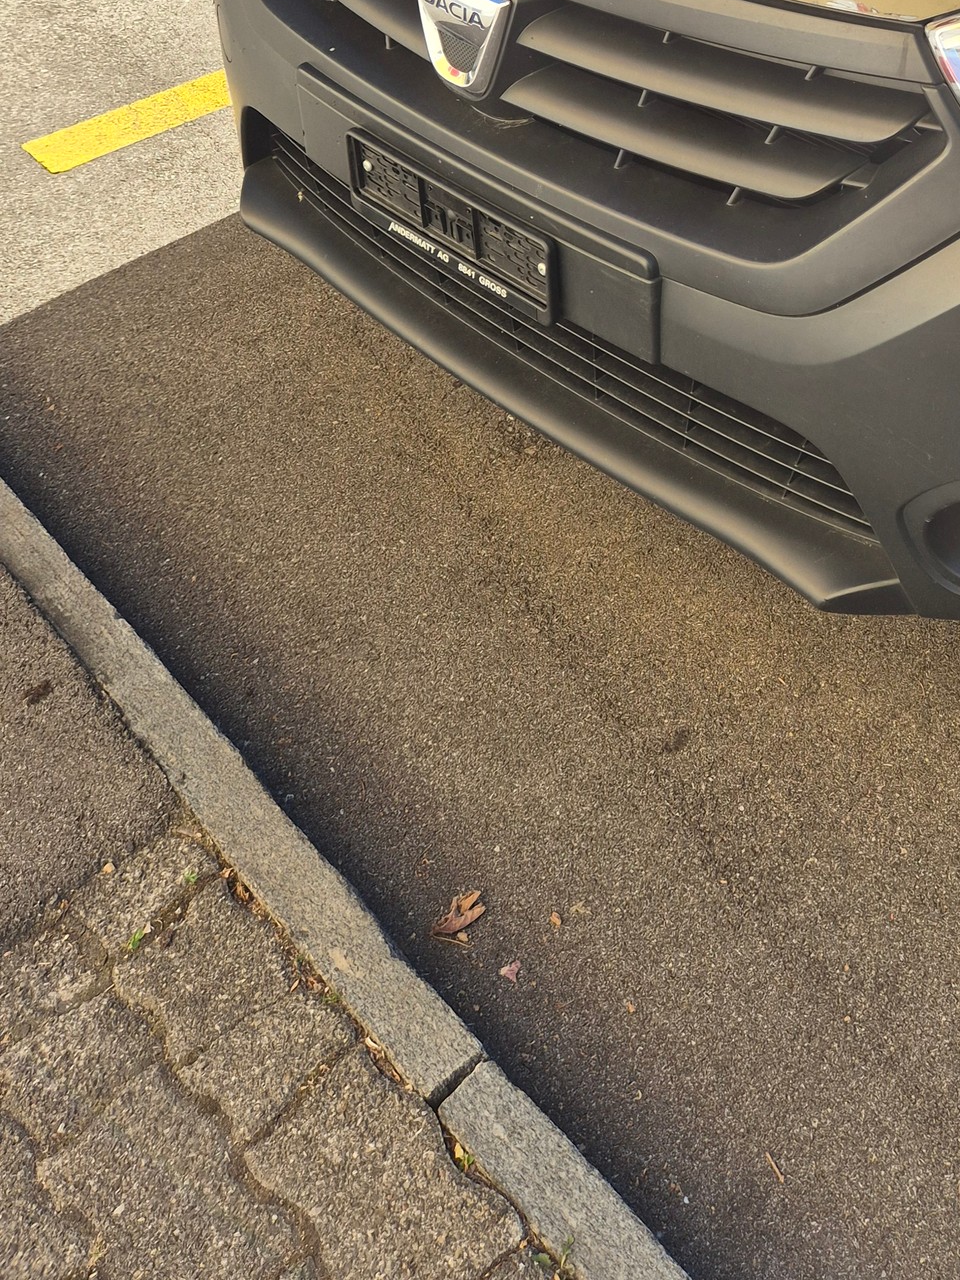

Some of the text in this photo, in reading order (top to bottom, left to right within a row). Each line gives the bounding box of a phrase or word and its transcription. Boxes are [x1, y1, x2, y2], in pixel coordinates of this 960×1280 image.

[387, 221, 436, 253] ANDERMATT
[437, 250, 449, 263] AG
[478, 275, 508, 298] GROSS
